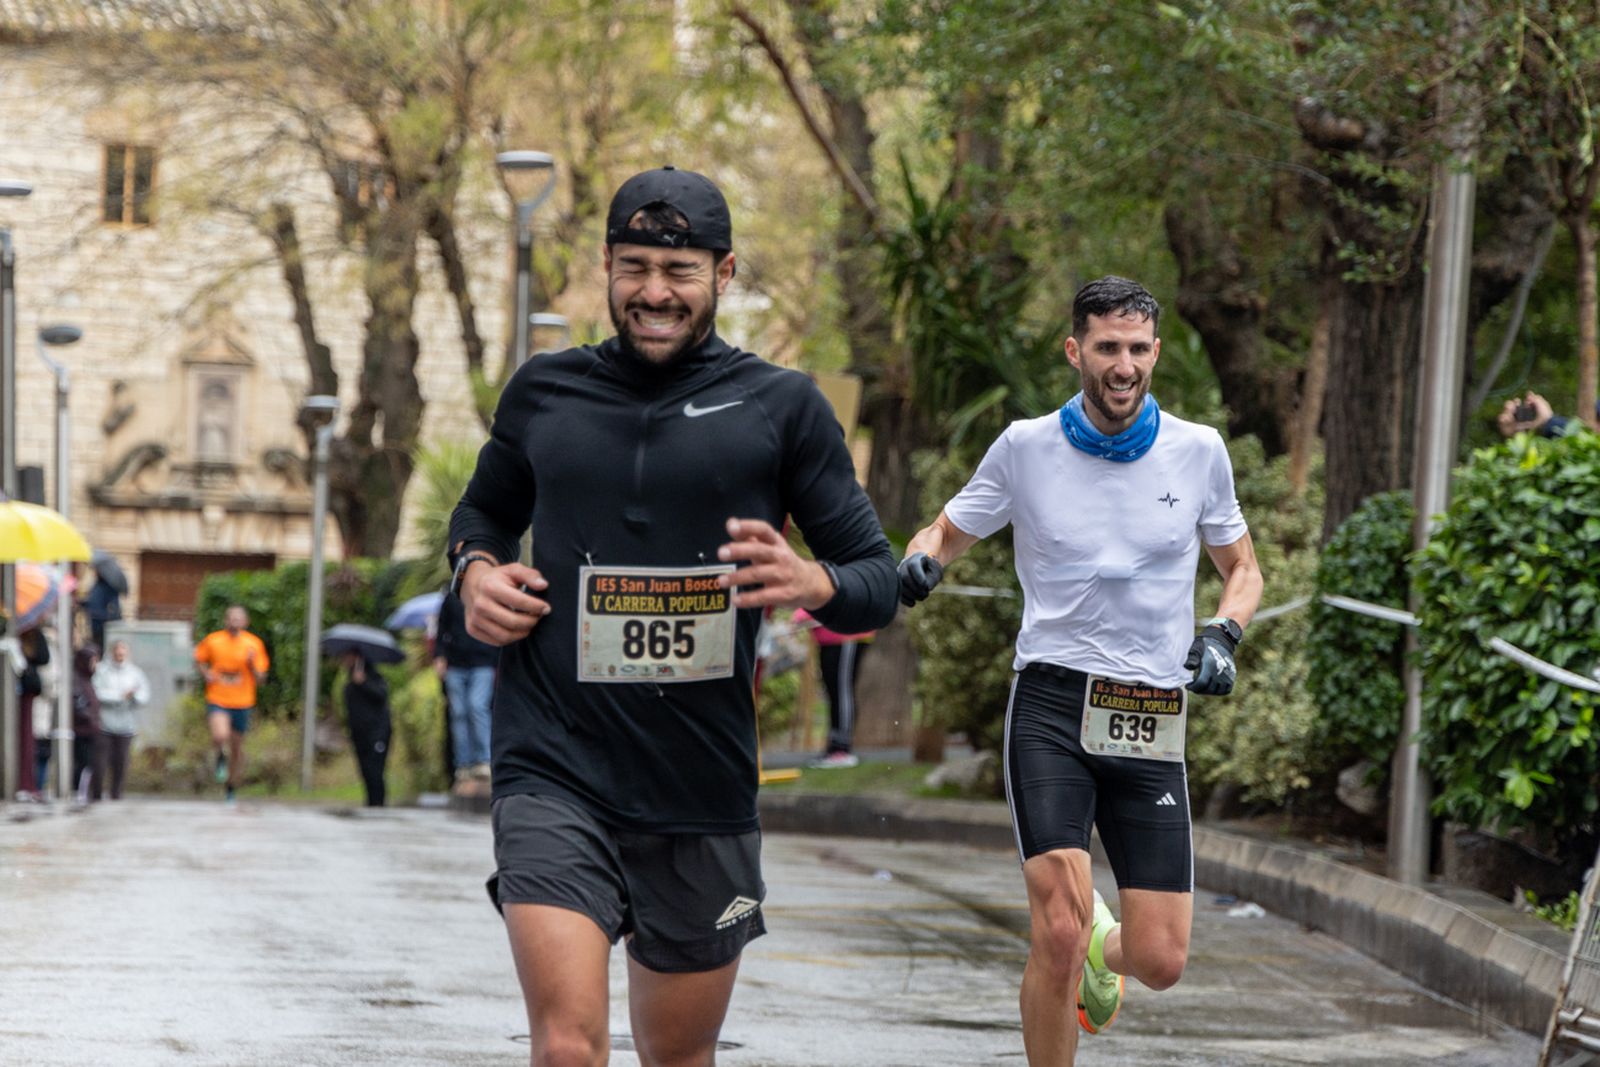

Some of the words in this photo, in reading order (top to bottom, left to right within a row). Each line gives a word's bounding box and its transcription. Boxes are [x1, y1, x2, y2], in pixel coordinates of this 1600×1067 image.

[596, 577, 617, 592] IES
[620, 578, 646, 592] San
[648, 579, 681, 593] Juan
[684, 577, 721, 592] Bosco
[592, 595, 601, 611] V
[605, 595, 664, 612] CARRERA
[669, 594, 725, 612] POPULAR
[622, 619, 695, 661] 865
[1112, 685, 1130, 697] San
[1132, 687, 1151, 698] Juan
[1092, 694, 1099, 705] V
[1101, 694, 1140, 711] CARRERA
[1142, 700, 1179, 713] POPULAR
[1109, 713, 1157, 743] 639
